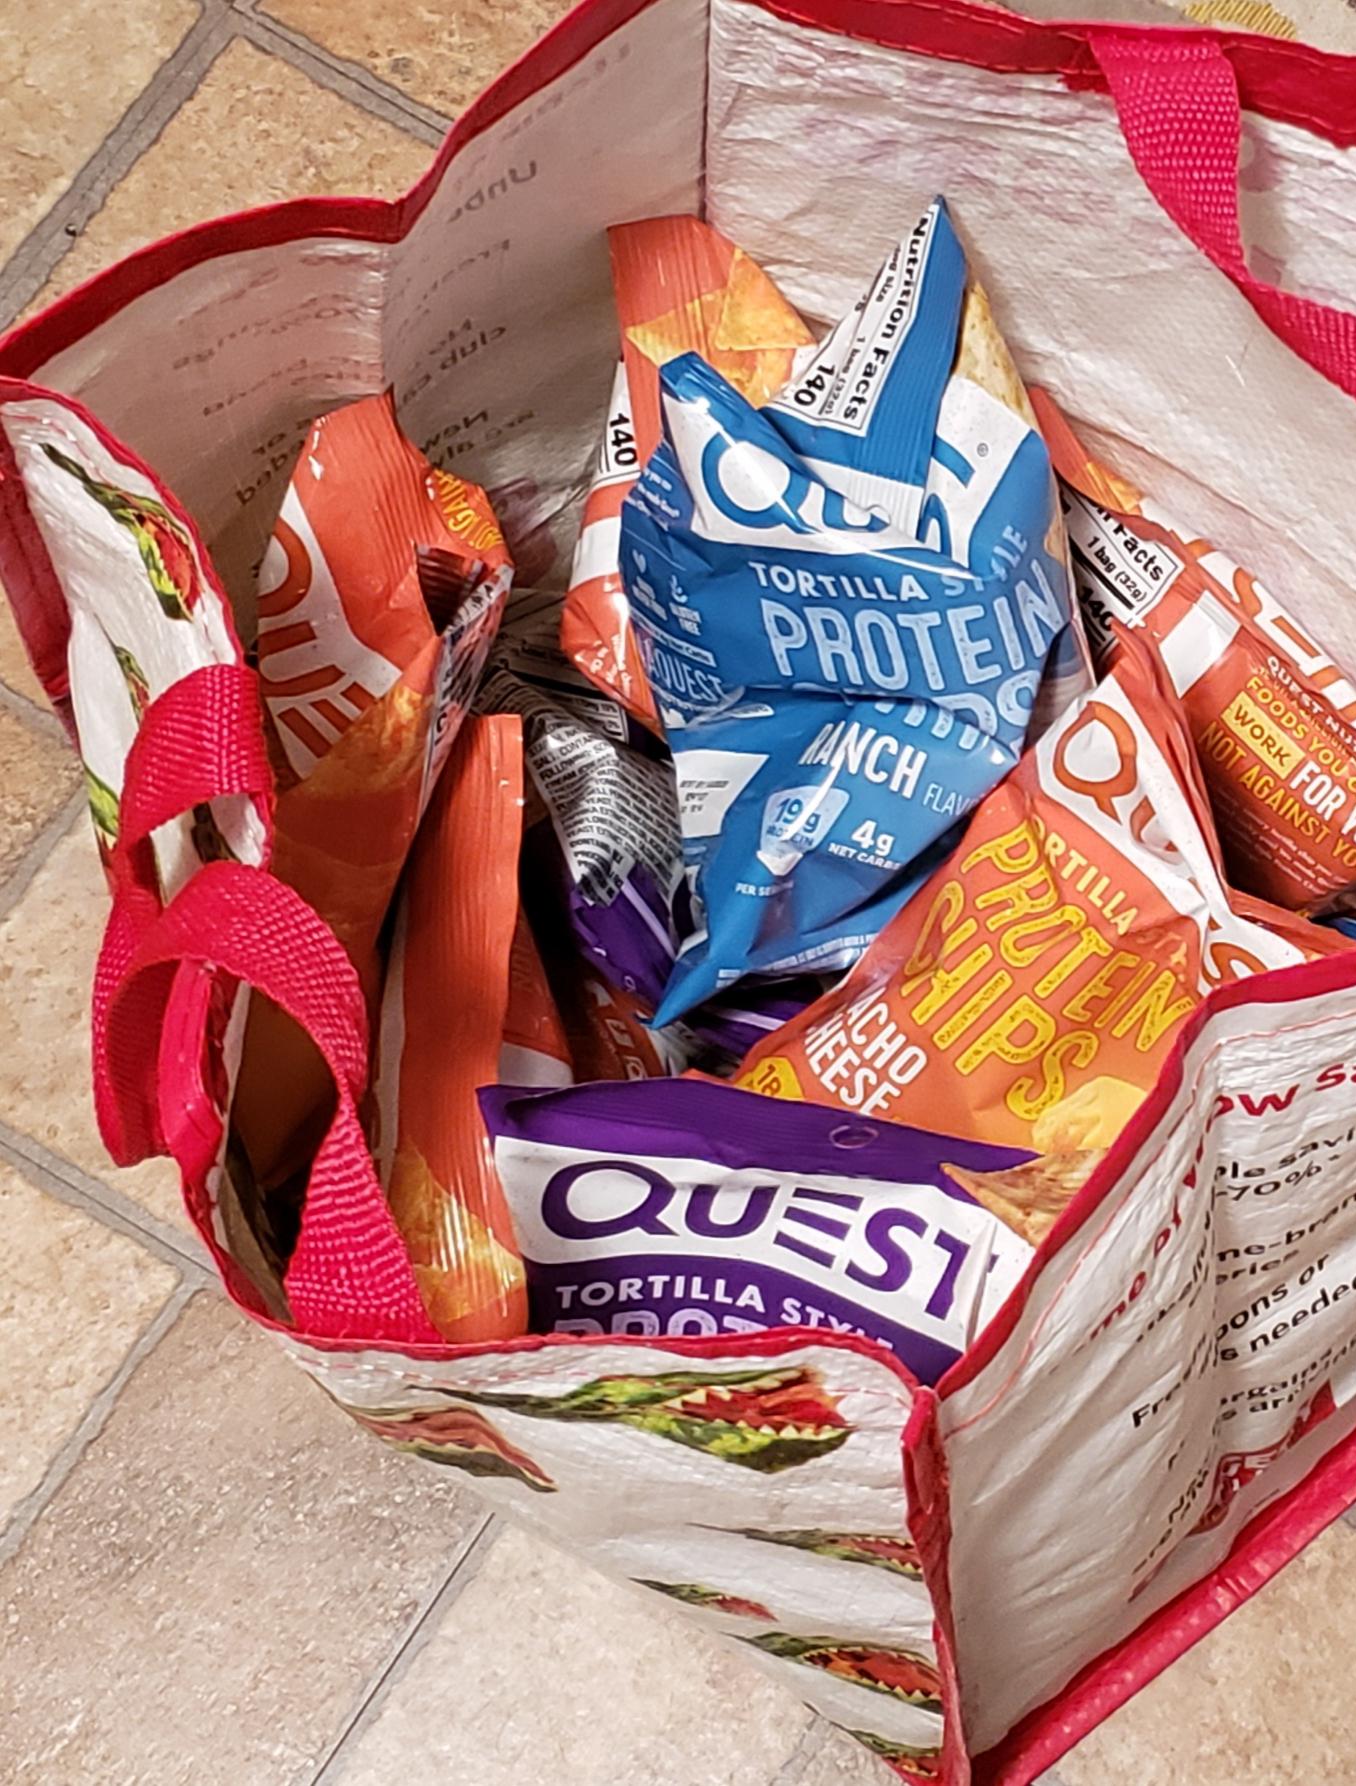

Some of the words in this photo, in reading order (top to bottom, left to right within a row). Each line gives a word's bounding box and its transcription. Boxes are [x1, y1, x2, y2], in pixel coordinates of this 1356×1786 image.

[881, 217, 929, 340] Nutrition
[794, 363, 836, 406] 140
[843, 347, 889, 421] Facts
[610, 412, 638, 466] 140
[749, 561, 929, 602] TORTILLA
[1094, 546, 1117, 574] bag
[1114, 570, 1148, 602] (32g)
[760, 559, 1066, 692] PROTEIN
[1233, 703, 1292, 768] WORK
[1288, 759, 1347, 821] FOR
[1246, 675, 1310, 740] FOODS
[1308, 738, 1349, 777] YOU
[800, 721, 927, 800] RANCH
[922, 783, 980, 818] FLAV
[1202, 720, 1248, 771] NOT
[1239, 764, 1331, 844] AGAINST
[828, 842, 858, 861] NET
[851, 820, 895, 857] 4g
[960, 819, 1194, 1053] PROTEIN
[900, 880, 1099, 1121] CHIPS
[541, 1159, 998, 1322] QUEST
[1298, 1253, 1330, 1287] or
[556, 1274, 766, 1313] TORTILLA
